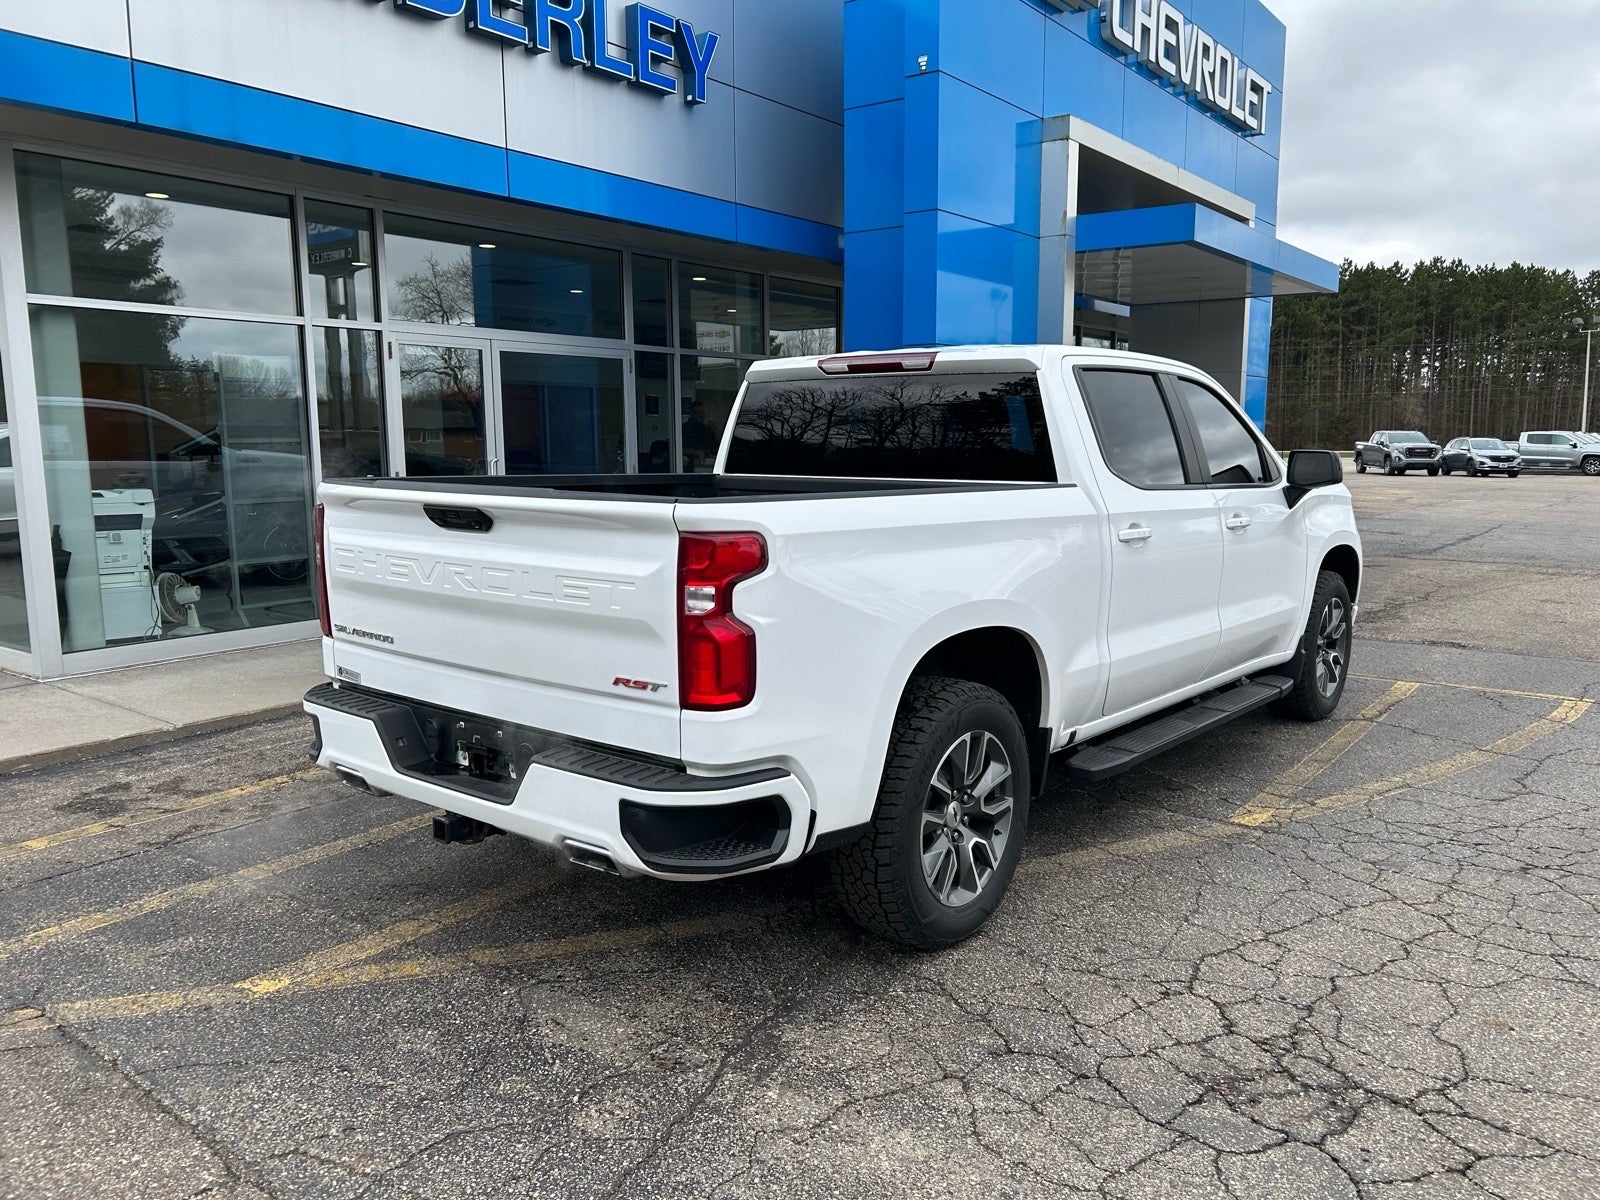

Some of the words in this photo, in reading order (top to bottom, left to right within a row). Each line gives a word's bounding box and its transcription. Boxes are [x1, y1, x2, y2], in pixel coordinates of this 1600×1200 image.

[395, 0, 720, 104] RLEY
[1102, 0, 1272, 135] CHEVROLET
[334, 547, 637, 610] CHEVROLET
[611, 676, 669, 693] RST
